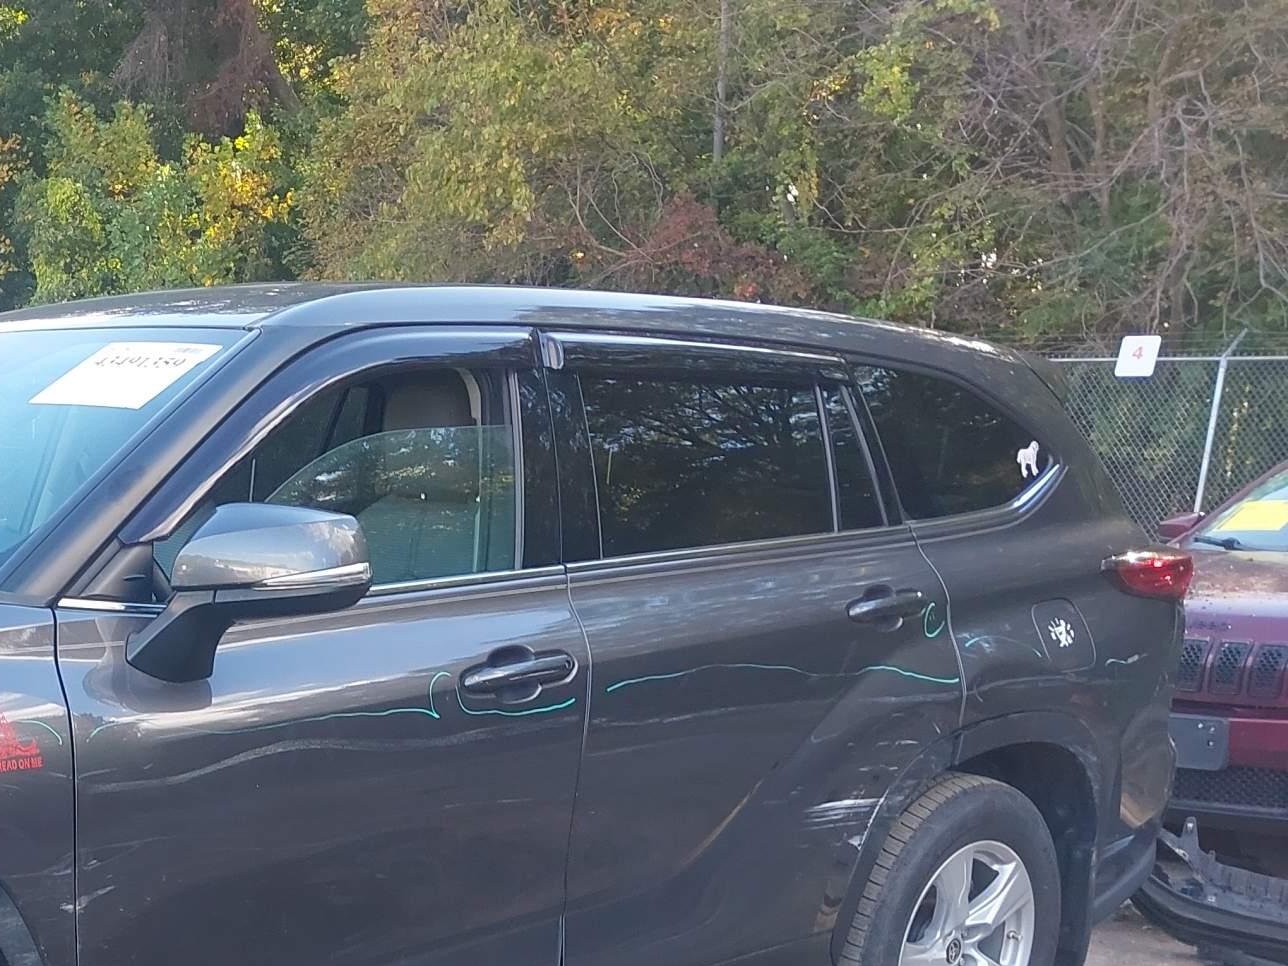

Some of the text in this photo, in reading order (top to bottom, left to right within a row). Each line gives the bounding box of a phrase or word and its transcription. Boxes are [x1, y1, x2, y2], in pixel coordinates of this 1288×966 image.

[1132, 346, 1143, 360] 4
[18, 758, 31, 769] ON
[31, 756, 44, 768] ME
